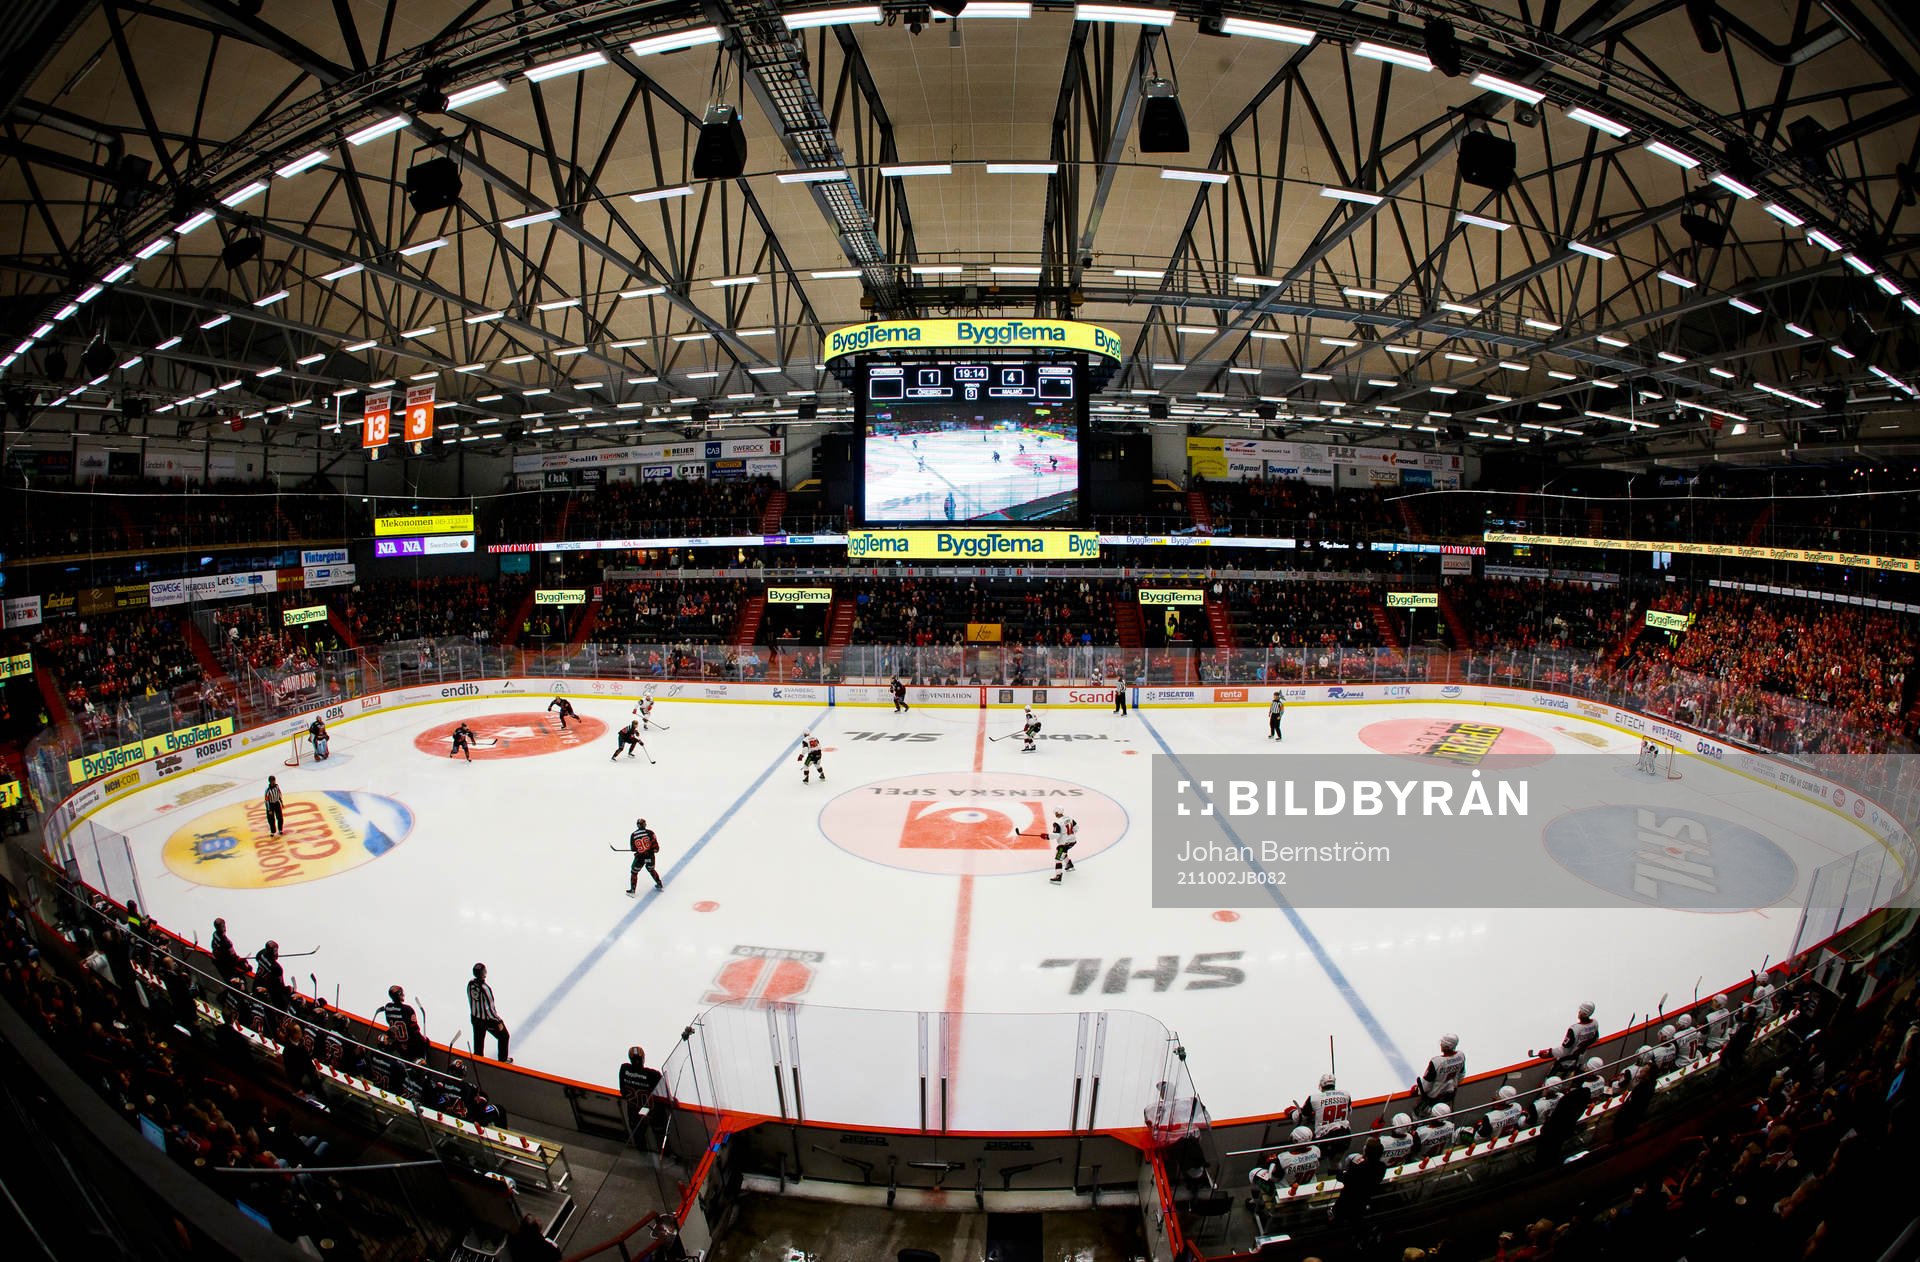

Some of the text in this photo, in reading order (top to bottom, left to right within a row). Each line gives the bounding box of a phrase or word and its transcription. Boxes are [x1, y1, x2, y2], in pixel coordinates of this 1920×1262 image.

[832, 325, 921, 351] ByggTema
[957, 322, 1065, 345] ByggTema
[928, 374, 934, 387] 1
[958, 369, 984, 382] 19:14
[1006, 374, 1014, 387] 4
[968, 389, 975, 398] 3
[1001, 388, 1023, 396] MALMÖ
[412, 408, 426, 434] 3
[368, 415, 386, 441] 13
[672, 447, 694, 455] BEIJER
[645, 468, 671, 477] VAP
[682, 466, 705, 475] PTM
[548, 472, 568, 483] Oak
[381, 518, 433, 529] Mekonomen
[403, 539, 422, 552] NA
[937, 534, 1044, 557] ByggTema
[1126, 536, 1207, 545] ByggTema ByggTema
[378, 541, 397, 554] NA
[305, 551, 345, 564] Vintergatan
[217, 575, 234, 586] Let's
[536, 591, 584, 605] ByggTema
[769, 590, 830, 604] ByggTema
[1140, 591, 1202, 604] ByggTema
[1388, 594, 1436, 607] ByggTema
[285, 608, 327, 625] ByggTema
[1647, 613, 1688, 631] ByggTema
[442, 683, 475, 697] endit
[930, 692, 972, 700] VENTILATION
[1158, 691, 1195, 699] PISCATOR
[1539, 696, 1569, 709] bravida
[166, 724, 222, 752] ByggTema
[843, 731, 943, 742] SHL
[196, 737, 233, 759] ROBUST
[83, 746, 143, 776] ByggTema
[871, 786, 1084, 800] SVENSKA SPEL
[244, 800, 305, 882] NORRANDS
[635, 837, 650, 853] 96
[1037, 950, 1246, 995] SHL
[1320, 1096, 1348, 1107] PERSSON
